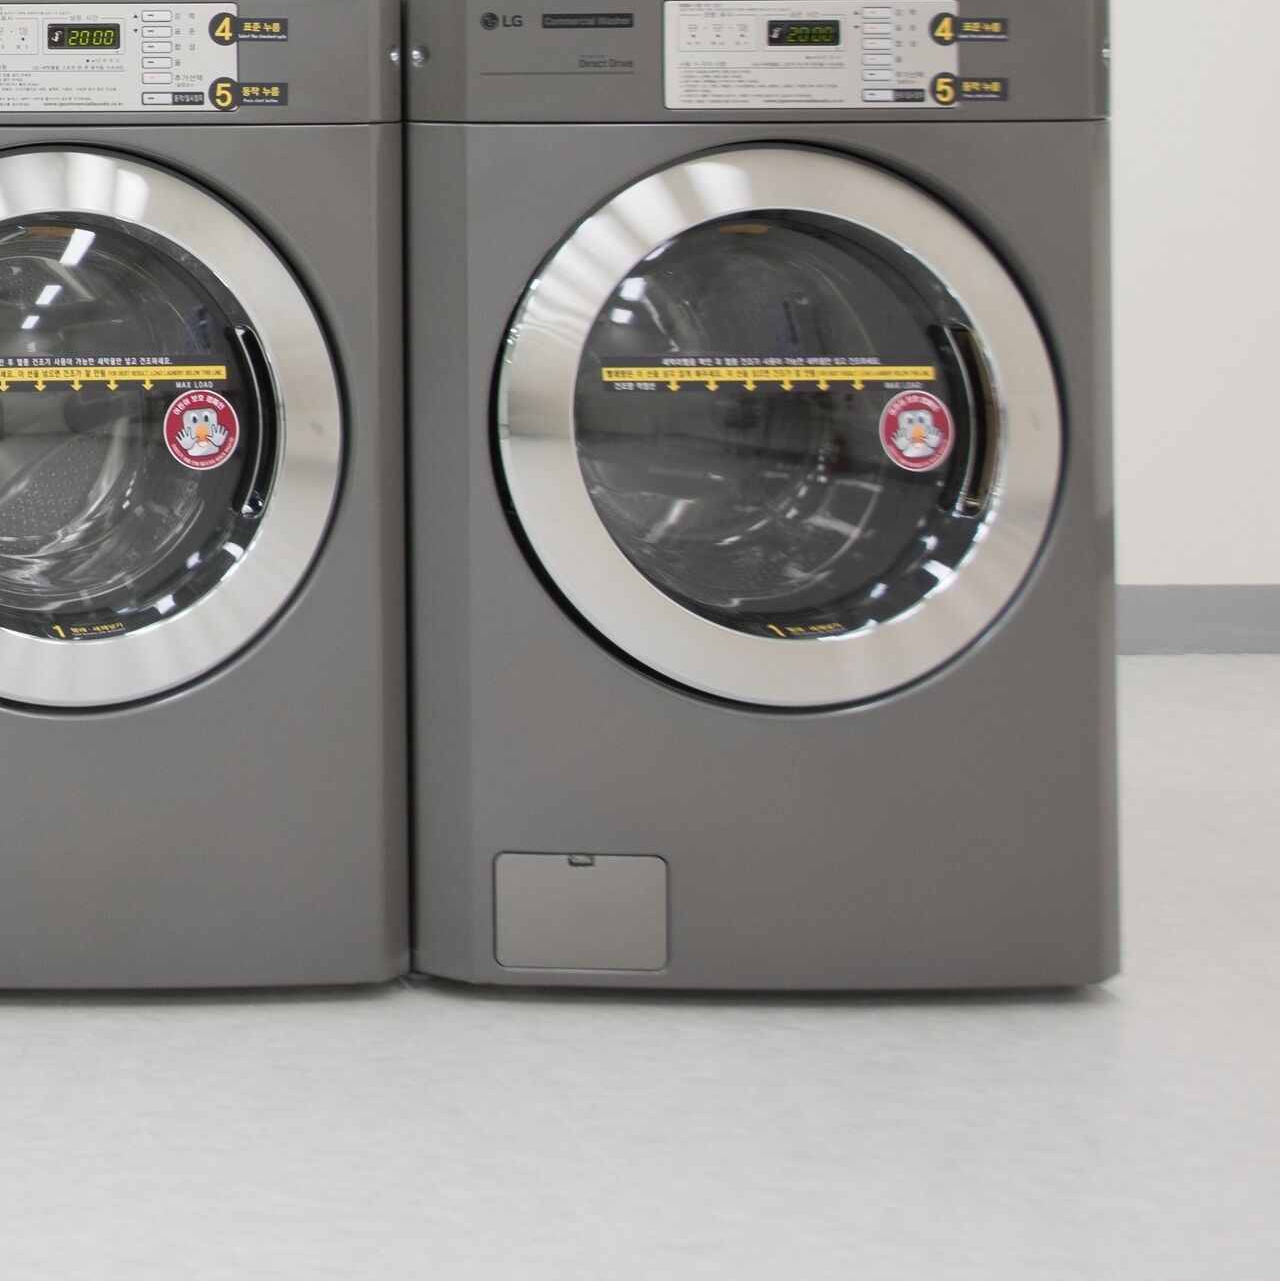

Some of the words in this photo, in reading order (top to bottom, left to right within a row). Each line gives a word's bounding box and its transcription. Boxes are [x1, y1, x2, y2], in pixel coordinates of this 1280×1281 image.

[242, 21, 261, 33] 표준
[263, 21, 282, 33] 누름
[502, 15, 523, 27] LG
[214, 17, 232, 40] 4
[934, 17, 954, 41] 4
[215, 83, 232, 106] 5
[241, 87, 260, 97] 동작
[262, 87, 280, 97] 누름
[935, 78, 955, 101] 5
[176, 381, 192, 389] MAX
[194, 381, 213, 389] LOAD
[52, 625, 66, 639] 1
